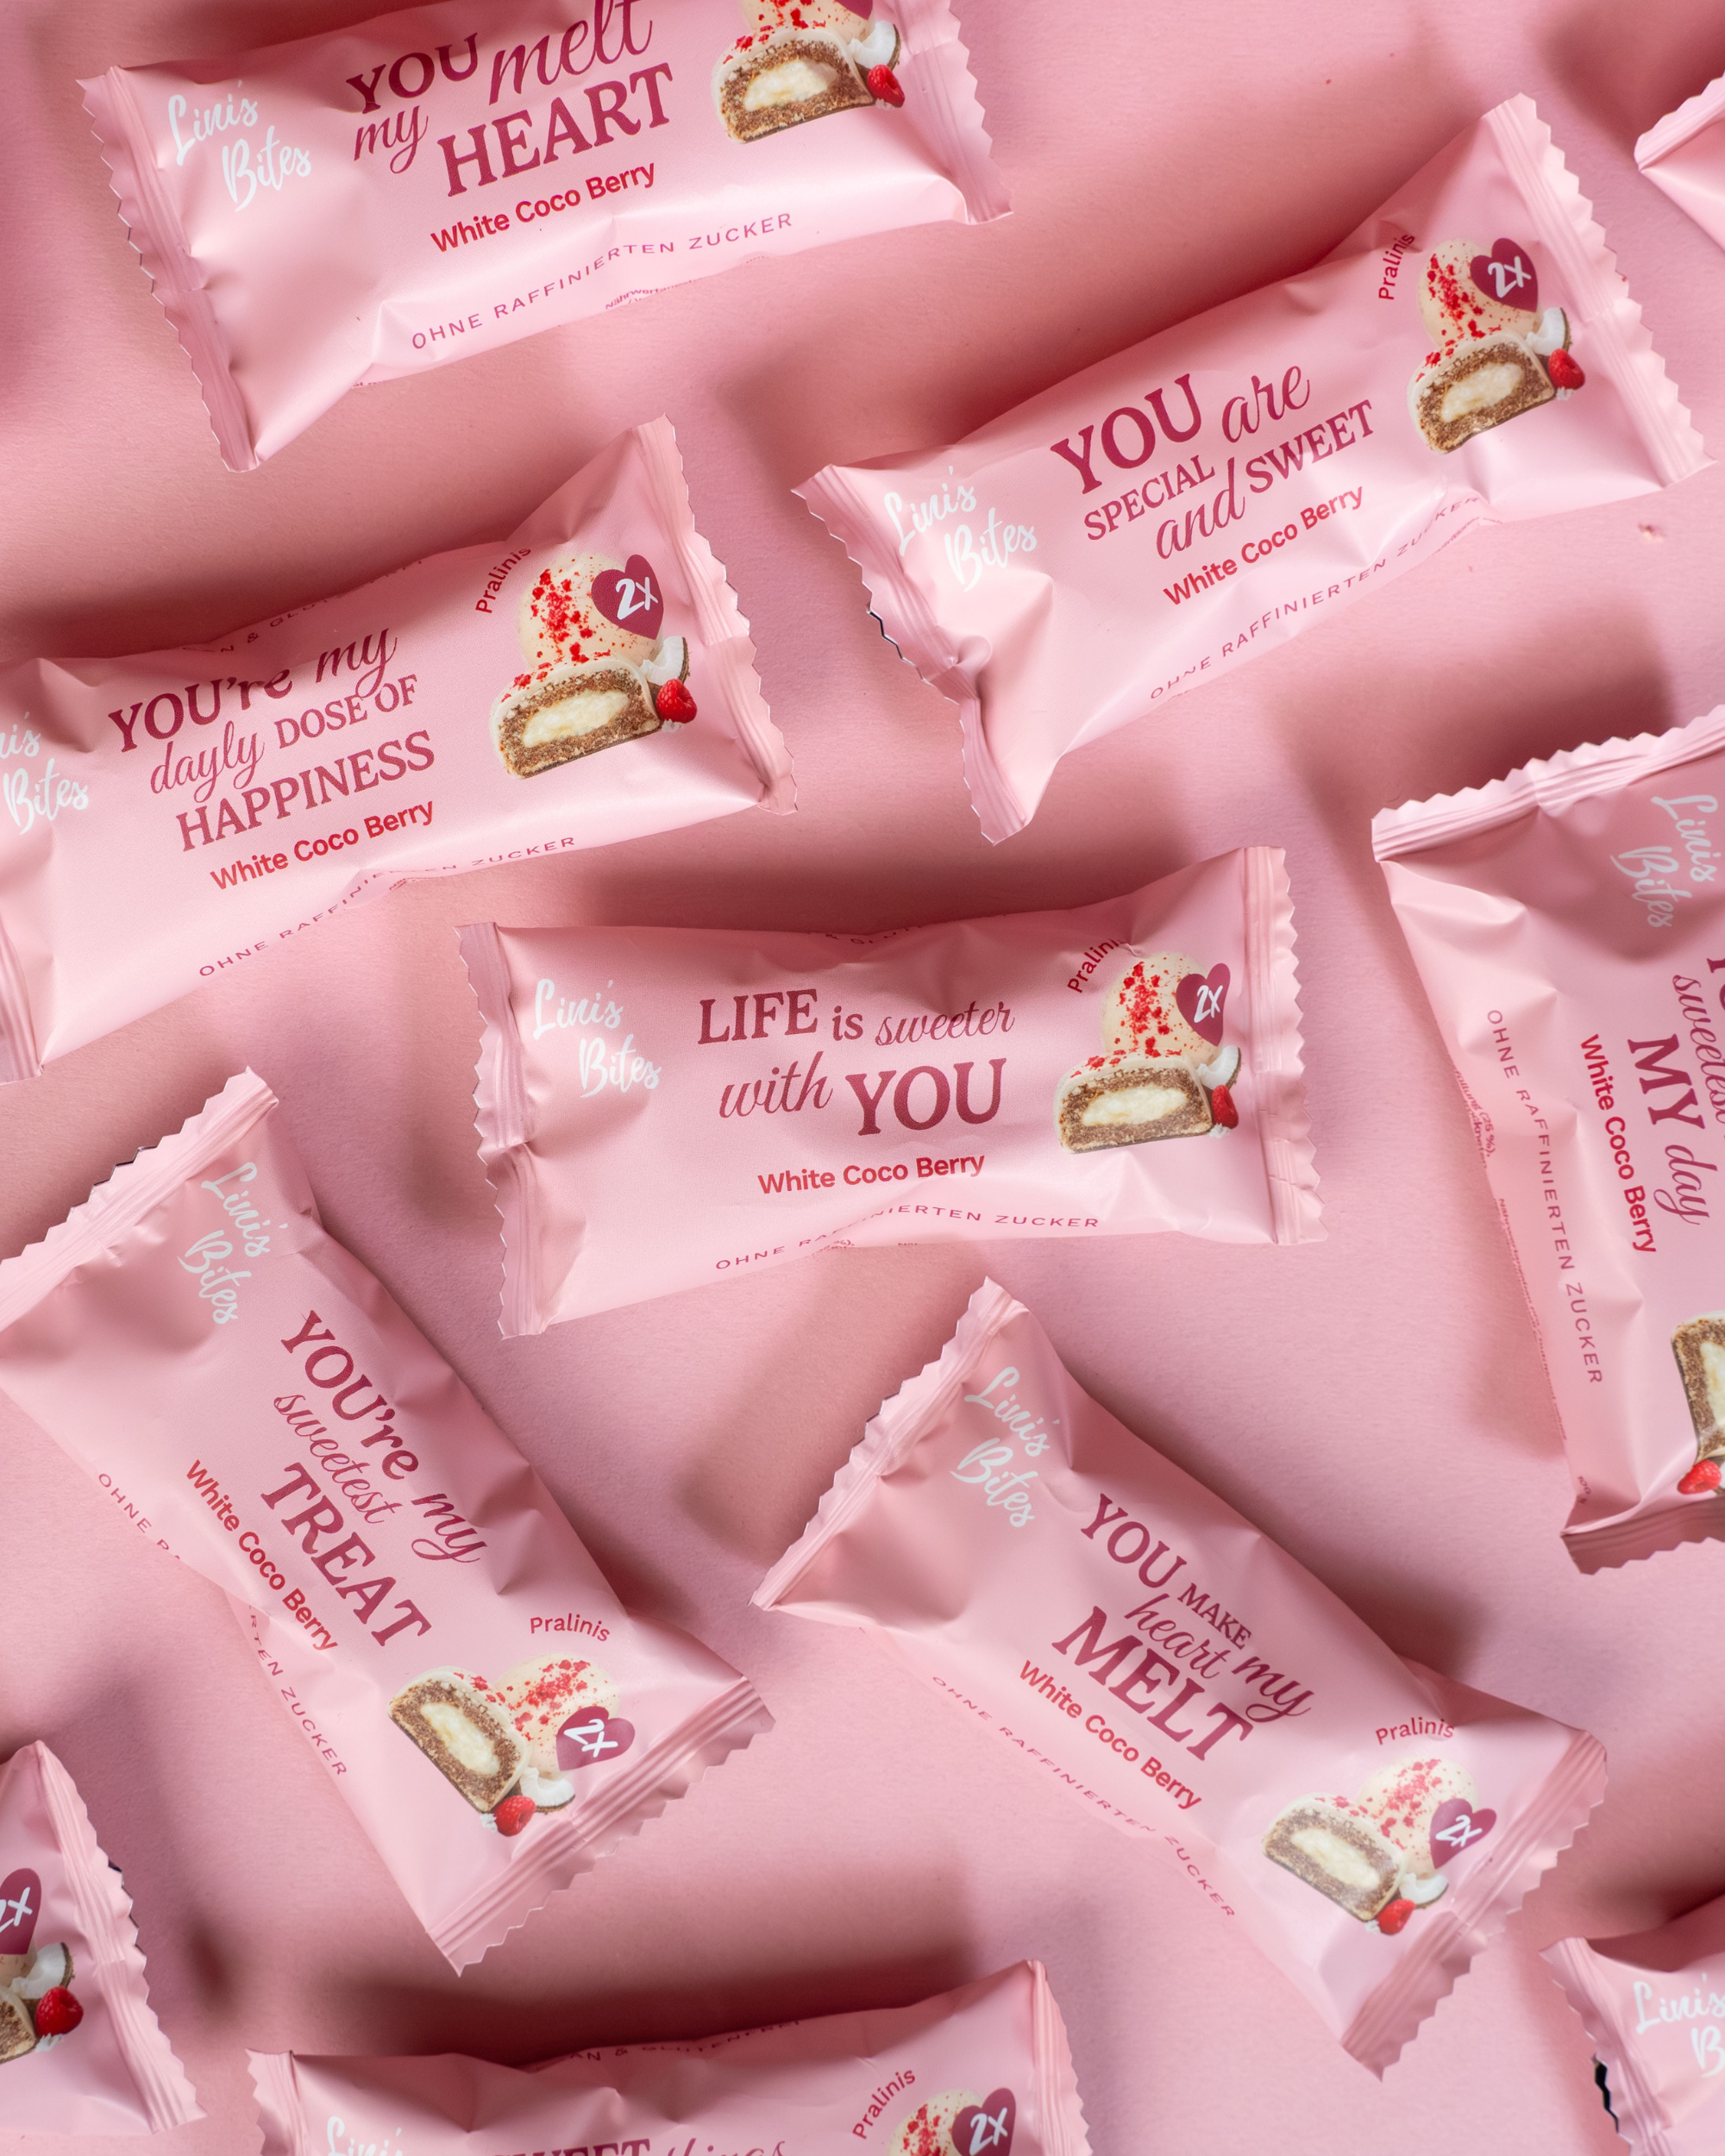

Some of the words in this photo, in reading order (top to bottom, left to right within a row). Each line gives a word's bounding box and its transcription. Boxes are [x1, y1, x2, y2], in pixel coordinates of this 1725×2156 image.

[346, 33, 478, 114] YOU
[489, 0, 652, 105] melt
[222, 125, 311, 212] Bites
[354, 106, 428, 174] my
[436, 62, 673, 197] HEART
[431, 212, 510, 253] White
[516, 190, 581, 223] Coco
[585, 162, 656, 200] Berry
[412, 313, 483, 349] OHNE
[494, 241, 674, 318] RAFFINIERTEN
[689, 213, 792, 249] ZUCKER
[1378, 232, 1414, 301] Pralinis
[1051, 373, 1203, 494] YOU
[1221, 366, 1310, 443] are
[1156, 458, 1245, 559] and
[1245, 399, 1374, 493] SWEET
[944, 507, 1036, 592] Bites
[1083, 454, 1215, 541] SPECIAL
[1164, 558, 1238, 605] White
[1240, 523, 1297, 564] Coco
[1300, 486, 1364, 530] Berry
[475, 546, 531, 614] Pralinis
[1151, 656, 1211, 699] OHNE
[1221, 558, 1386, 657] RAFFINIERTEN
[108, 667, 292, 753] YOU're
[316, 627, 398, 698] my
[149, 721, 266, 804] dayly
[274, 693, 367, 749] DOSE
[375, 674, 417, 712] OF
[3, 758, 89, 835] Bites
[177, 730, 435, 852] HAPPINESS
[210, 849, 289, 890] White
[293, 827, 359, 862] Coco
[364, 800, 434, 839] Berry
[199, 942, 268, 976] OHNE
[471, 837, 574, 866] ZUCKER
[1610, 846, 1692, 928] Bites
[580, 1033, 662, 1098] Bites
[697, 989, 818, 1044] LIFE
[831, 1006, 864, 1041] is
[875, 1000, 1015, 1046] sweeter
[718, 1050, 832, 1119] with
[845, 1057, 1007, 1137] YOU
[1628, 1033, 1705, 1129] MY
[758, 1170, 835, 1194] White
[843, 1162, 908, 1186] Coco
[916, 1155, 985, 1179] Berry
[1486, 1009, 1520, 1080] OHNE
[1515, 1088, 1575, 1271] RAFFINIERTEN
[1565, 1282, 1603, 1384] ZUCKER
[1580, 1033, 1615, 1111] White
[1605, 1117, 1634, 1180] Coco
[1624, 1185, 1657, 1252] Berry
[1653, 1144, 1718, 1225] day
[177, 1230, 252, 1325] Bites
[716, 1246, 786, 1269] OHNE
[994, 1215, 1098, 1227] ZUCKER
[273, 1394, 402, 1526] sweetest
[280, 1310, 419, 1481] YOU're
[411, 1493, 487, 1565] my
[950, 1438, 1038, 1527] Bites
[185, 1459, 241, 1532] White
[237, 1532, 285, 1590] Coco
[282, 1587, 339, 1652] Berry
[260, 1463, 431, 1647] TREAT
[1081, 1493, 1187, 1589] YOU
[1177, 1583, 1251, 1650] MAKE
[98, 1472, 153, 1535] OHNE
[281, 1687, 347, 1776] ZUCKER
[530, 1613, 611, 1642] Pralinis
[1125, 1594, 1233, 1680] heart
[1232, 1656, 1314, 1723] my
[1019, 1660, 1082, 1719] White
[1085, 1714, 1139, 1763] Coco
[1141, 1757, 1202, 1810] Berry
[1051, 1607, 1254, 1761] MELT
[1376, 1717, 1454, 1745] Pralinis
[932, 1677, 993, 1720] OHNE
[999, 1727, 1157, 1833] RAFFINIERTEN
[1164, 1836, 1235, 1917] ZUCKER
[852, 2070, 916, 2140] Pralinis
